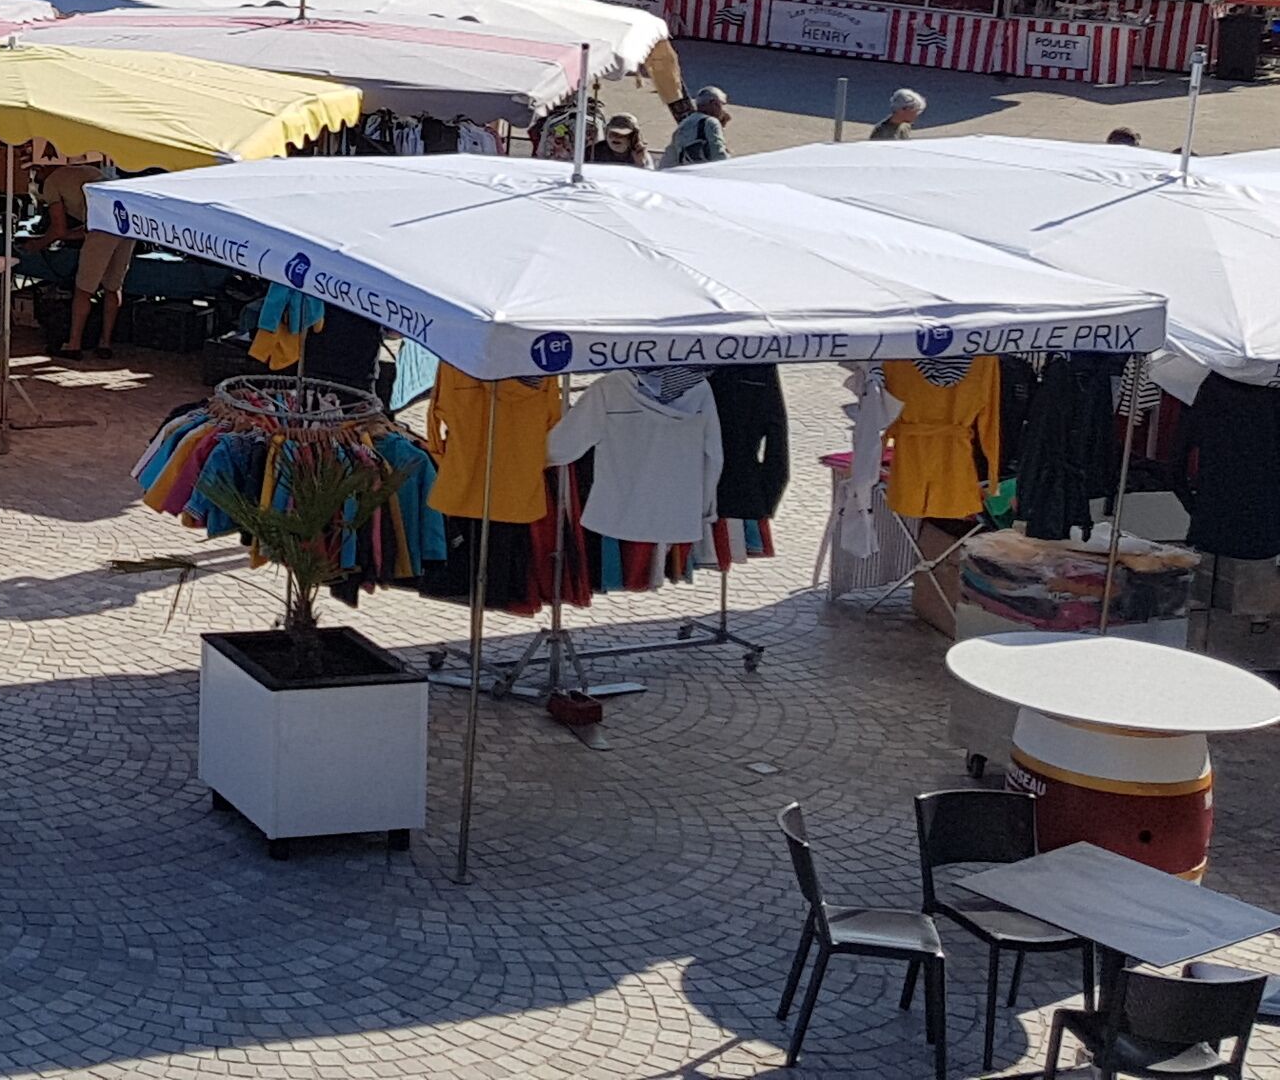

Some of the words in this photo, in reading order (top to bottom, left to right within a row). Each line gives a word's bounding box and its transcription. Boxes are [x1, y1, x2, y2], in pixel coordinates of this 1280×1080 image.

[801, 27, 851, 44] HENRY
[1035, 37, 1080, 50] POULET
[132, 213, 160, 241] SUR
[162, 222, 182, 246] LA
[182, 227, 250, 268] QUALITÉ
[286, 256, 309, 286] 1er
[314, 272, 352, 305] SUR
[359, 287, 382, 319] LE
[386, 299, 434, 343] PRIX
[533, 337, 571, 367] 1er
[588, 340, 658, 367] SUR
[667, 337, 706, 363] LA
[962, 329, 1025, 354] SUR
[1030, 325, 1069, 350] LE
[1073, 324, 1144, 351] PRIX
